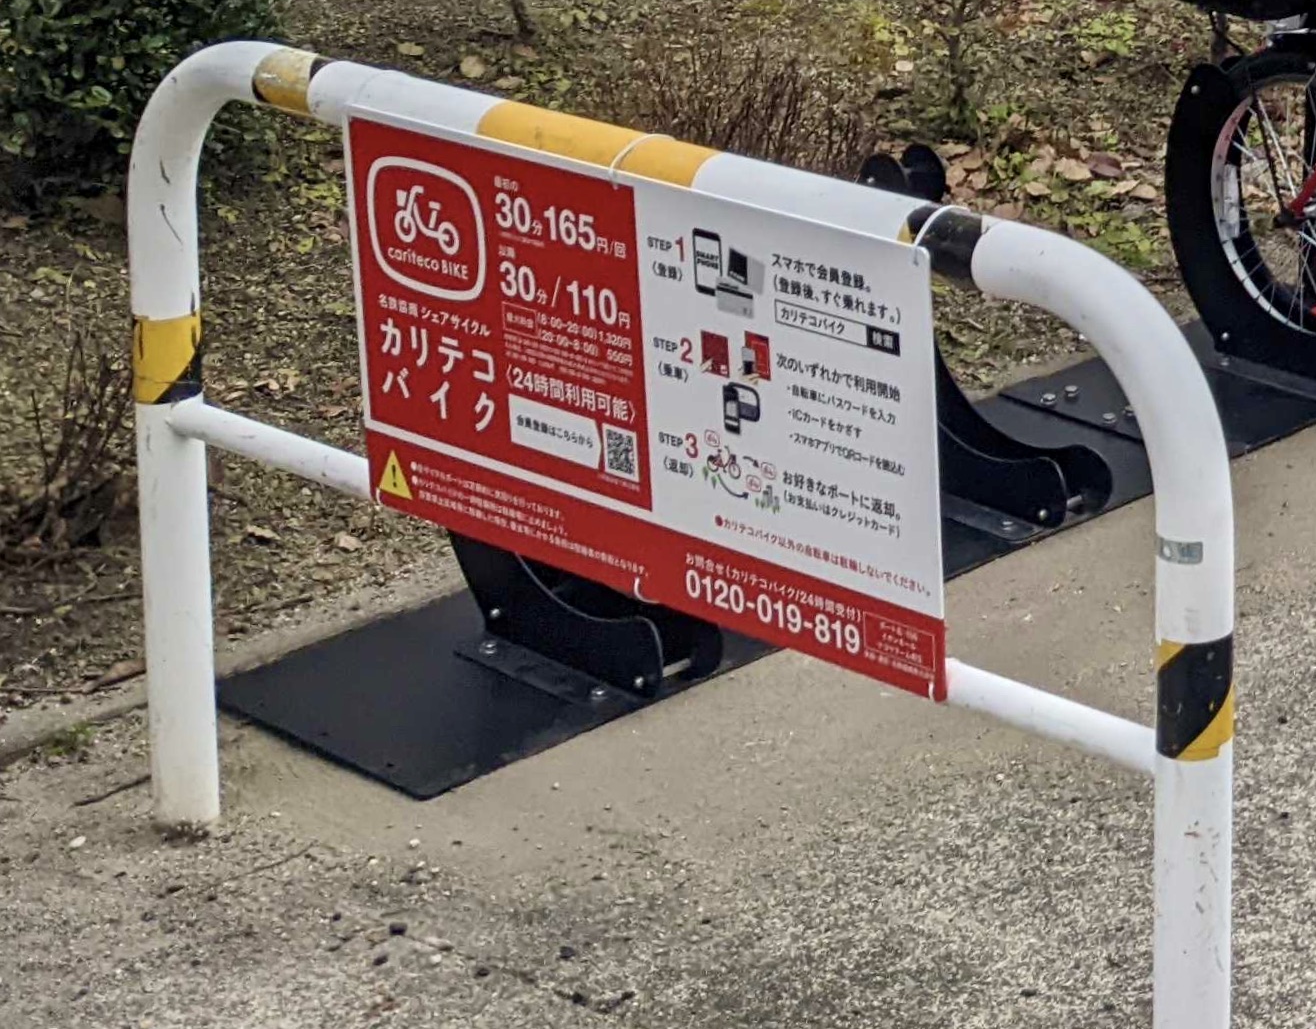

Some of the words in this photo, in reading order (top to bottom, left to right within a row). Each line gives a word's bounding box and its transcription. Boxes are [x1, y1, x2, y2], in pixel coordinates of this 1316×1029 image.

[387, 246, 440, 272] cariteco
[441, 259, 470, 281] BIKE
[647, 235, 673, 252] STEP
[674, 236, 685, 262] 1
[420, 306, 491, 338] シェアサイクル
[780, 307, 846, 336] カリテコバイク
[379, 317, 497, 384] カリテコ
[653, 337, 678, 353] STEP
[679, 338, 694, 364] 2
[775, 352, 901, 403] 次のいずれかで利用開始
[381, 367, 497, 433] バイク
[658, 431, 683, 447] STEP
[684, 433, 699, 459] 3
[685, 569, 861, 655] 0120-019-819
